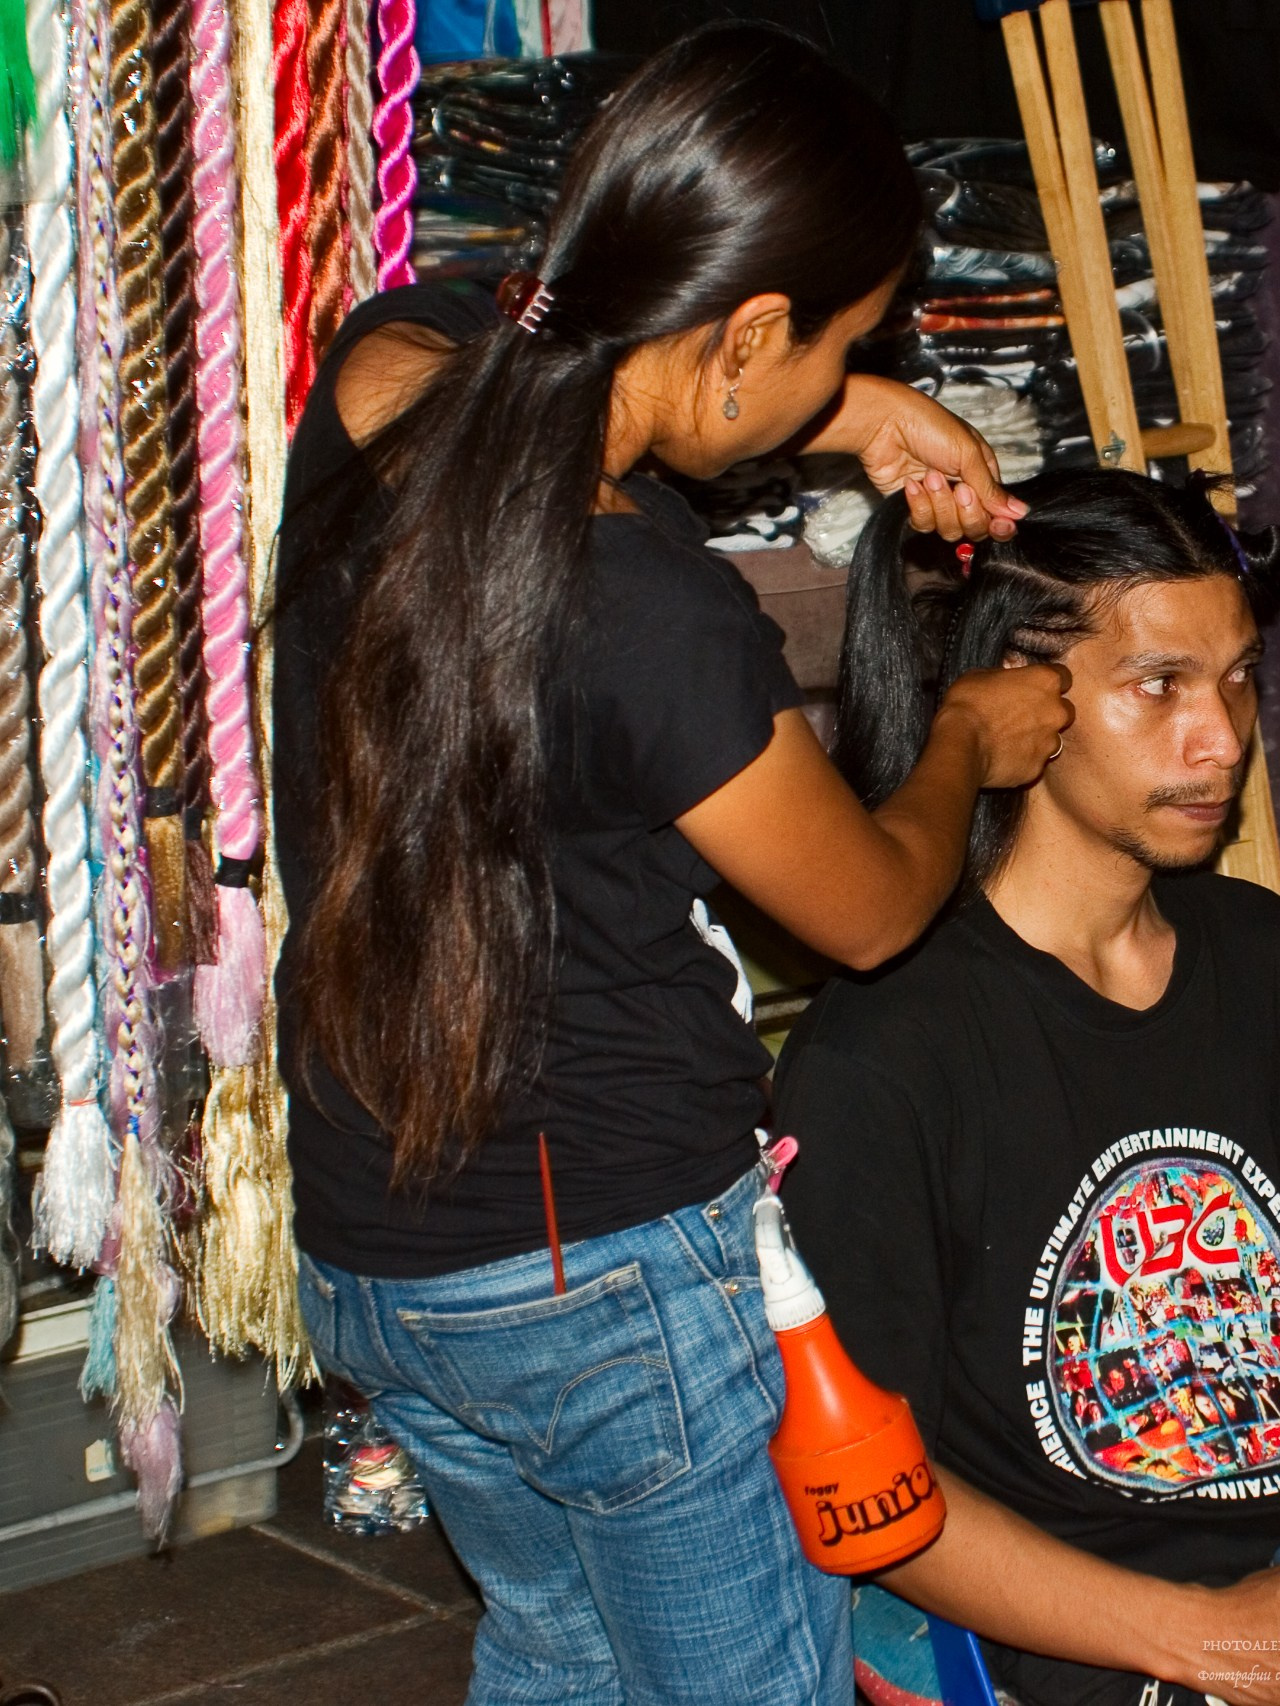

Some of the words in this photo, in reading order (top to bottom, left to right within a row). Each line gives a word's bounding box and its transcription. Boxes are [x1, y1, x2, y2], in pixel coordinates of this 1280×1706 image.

[1091, 1127, 1244, 1183] ENTERTAINMENT
[1029, 1174, 1095, 1301] ULTIMATE
[1023, 1307, 1044, 1366] THE
[804, 1482, 839, 1497] foggy
